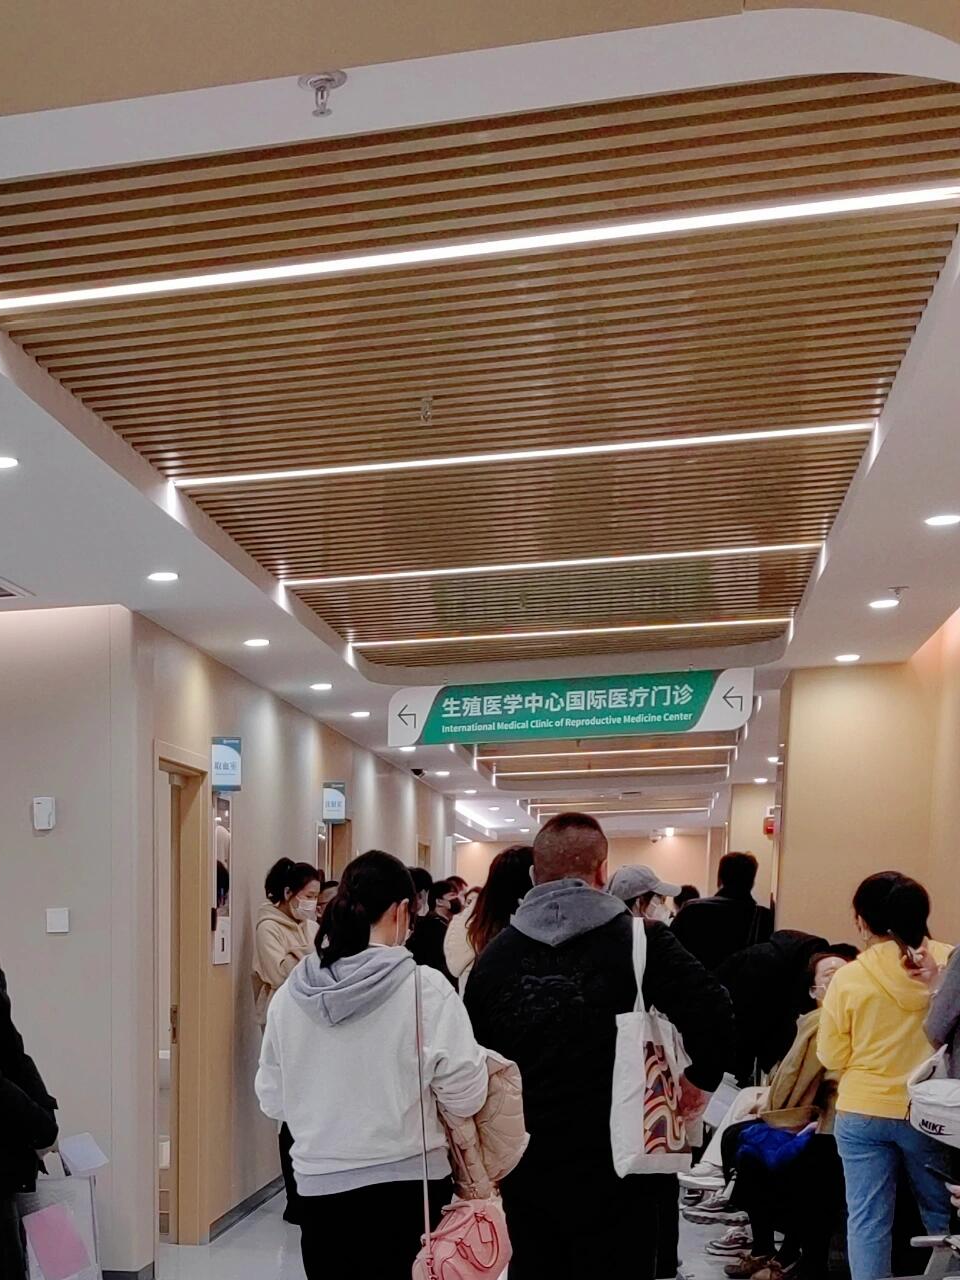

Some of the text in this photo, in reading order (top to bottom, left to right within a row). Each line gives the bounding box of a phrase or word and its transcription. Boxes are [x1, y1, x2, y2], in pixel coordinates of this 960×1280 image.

[442, 684, 694, 718] 生殖医学中心国际医疗门诊
[442, 712, 693, 733] International Medical Clinic of Reproductive Medicine Center
[921, 1118, 946, 1136] NIKE
